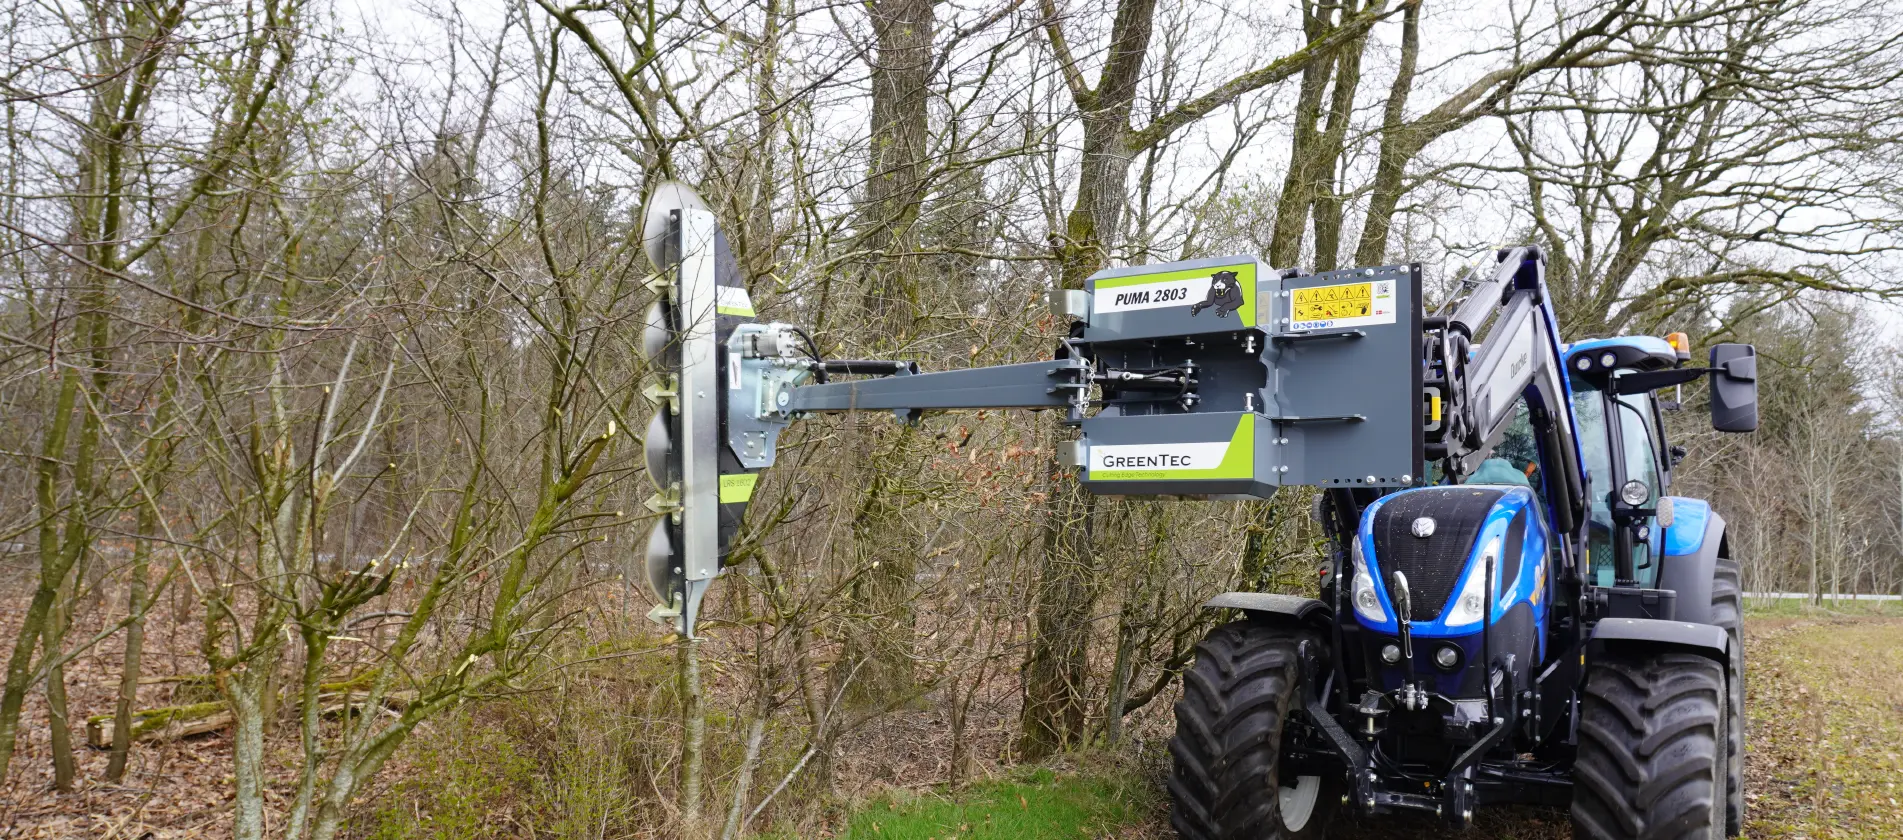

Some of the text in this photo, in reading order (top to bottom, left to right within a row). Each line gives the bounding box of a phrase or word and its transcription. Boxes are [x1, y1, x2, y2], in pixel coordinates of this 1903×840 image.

[1115, 288, 1188, 306] PUMA 2803
[1135, 471, 1166, 479] Technology
